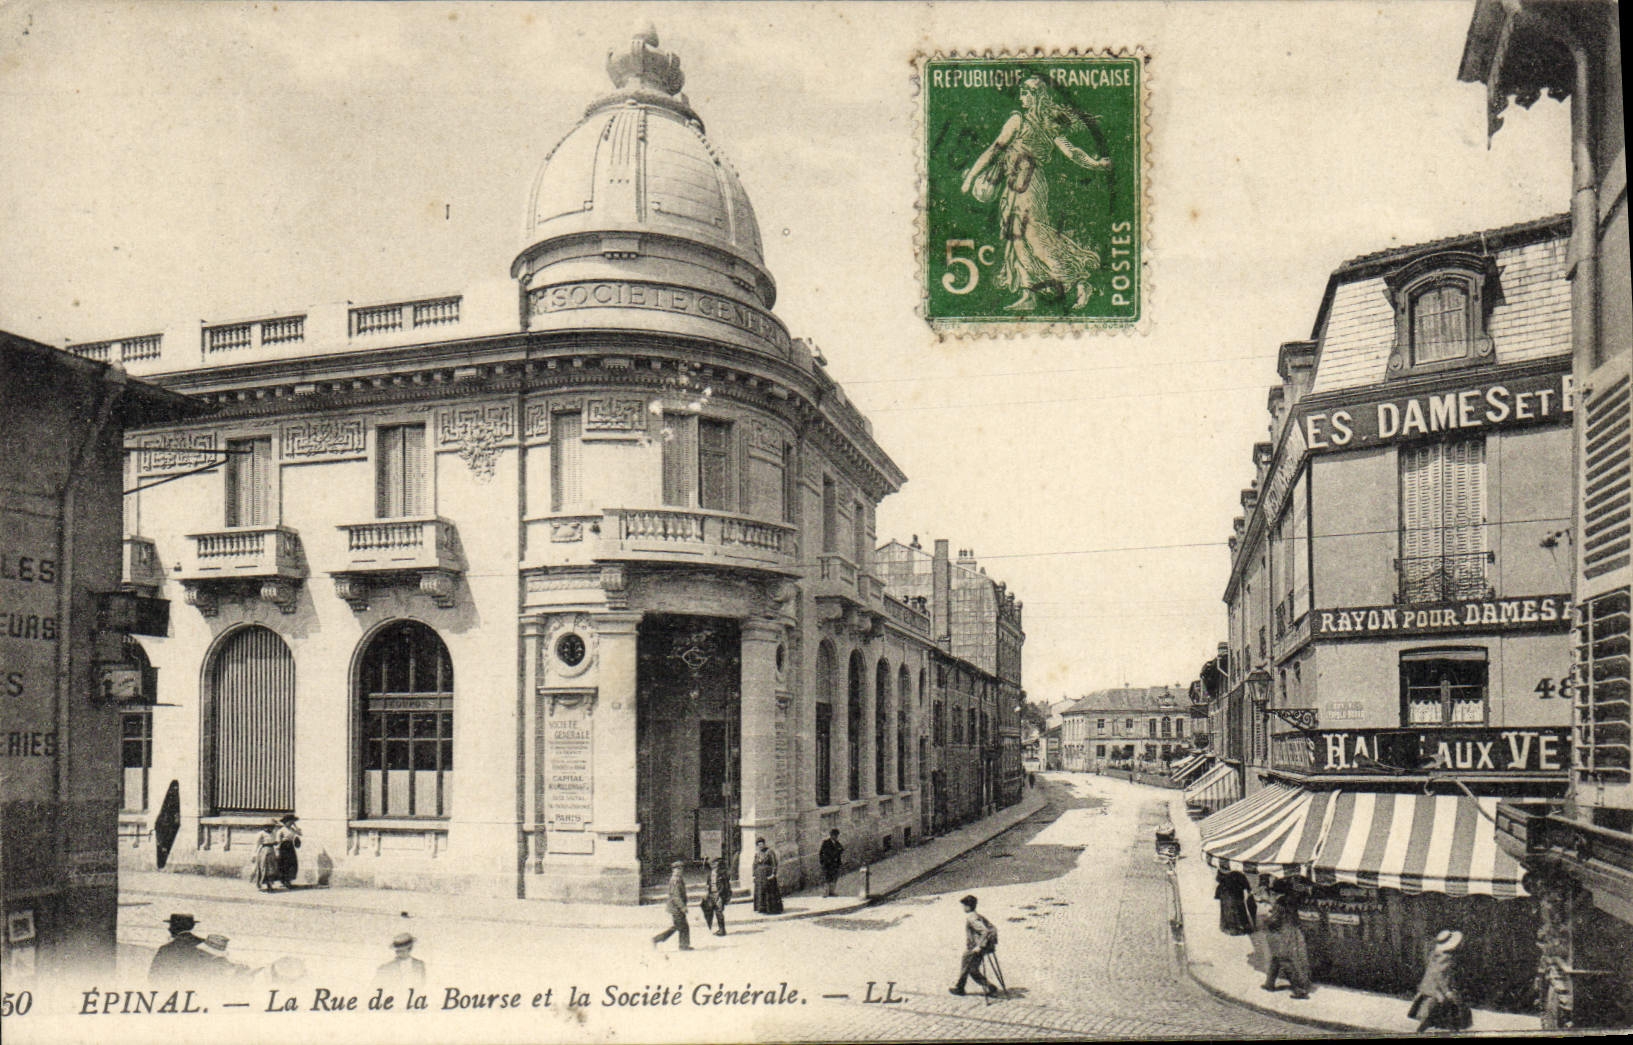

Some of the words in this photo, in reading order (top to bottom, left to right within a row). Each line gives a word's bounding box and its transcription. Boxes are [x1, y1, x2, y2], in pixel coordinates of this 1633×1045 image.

[1050, 68, 1131, 89] FRANÇAISE
[1111, 221, 1131, 306] POSTES
[1377, 386, 1510, 439] DAMES
[1515, 389, 1555, 419] ET
[1320, 608, 1399, 633] RAYON
[1402, 608, 1460, 629] POUR
[1463, 598, 1557, 625] DAMES
[1437, 741, 1495, 769] AUX
[1501, 729, 1573, 770] VÊ
